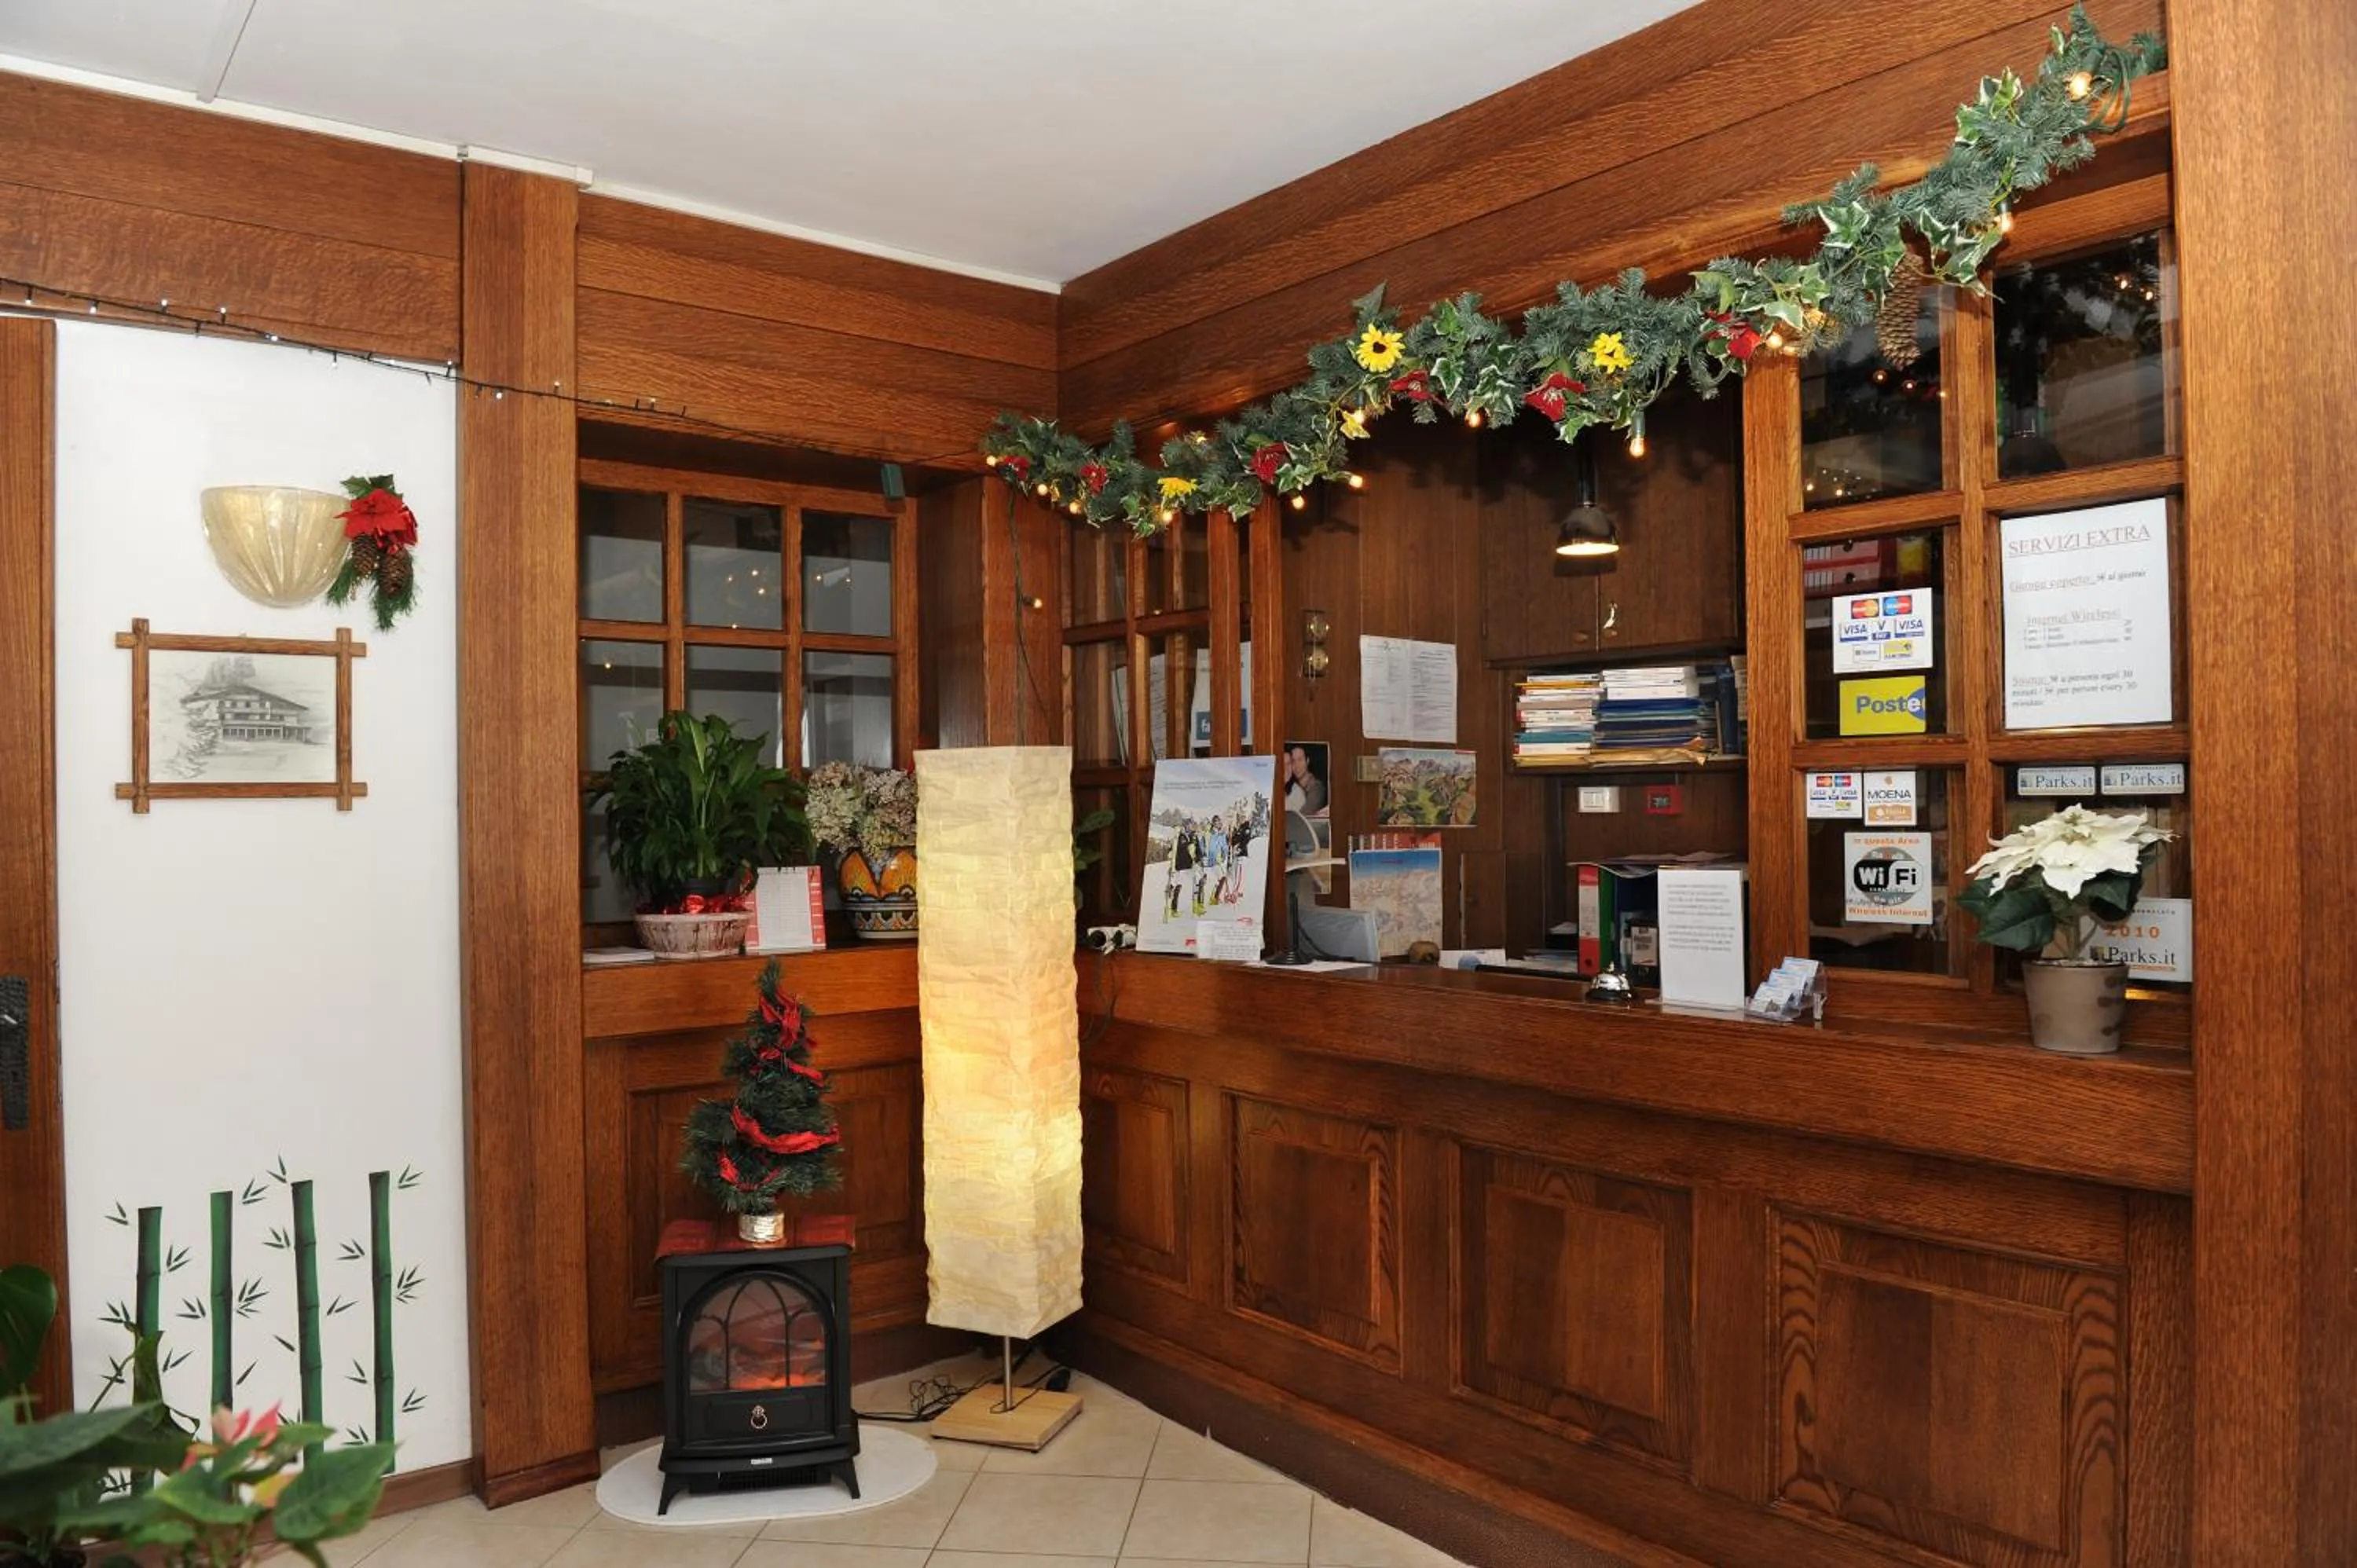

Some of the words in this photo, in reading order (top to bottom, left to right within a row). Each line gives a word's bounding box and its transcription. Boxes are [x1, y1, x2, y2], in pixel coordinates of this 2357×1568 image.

[2008, 533, 2081, 557] SERVIZI
[2087, 524, 2151, 548] EXTRA
[1844, 624, 1868, 635] VISA
[1878, 620, 1886, 630] V
[1899, 619, 1923, 629] VISA
[2035, 775, 2093, 789] Parks.it
[2121, 771, 2182, 786] Parks.it
[1868, 789, 1912, 799] MOENA
[2108, 946, 2176, 965] Parks.it
